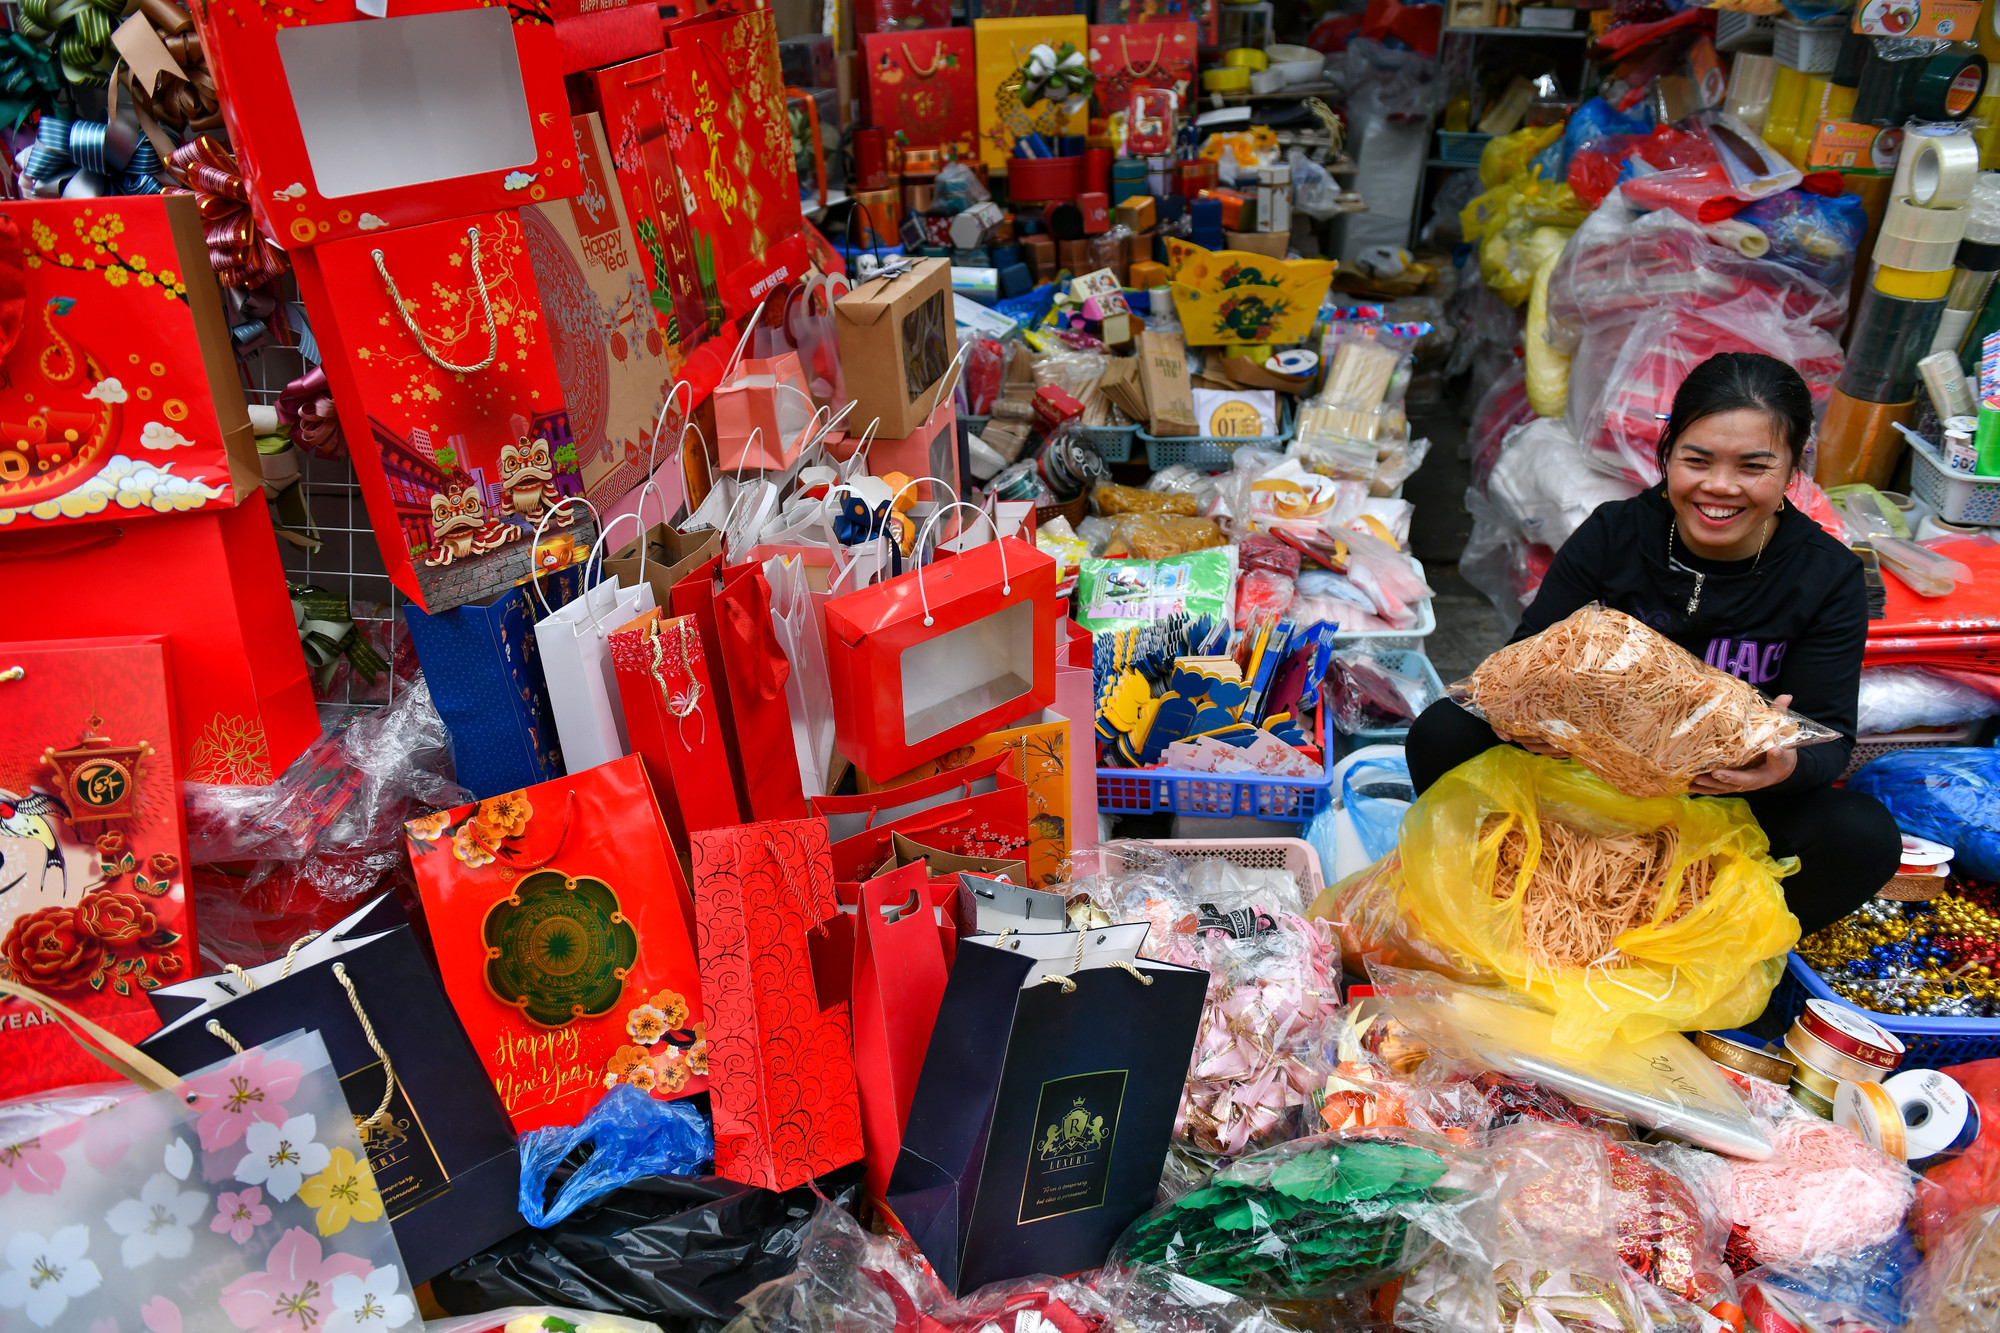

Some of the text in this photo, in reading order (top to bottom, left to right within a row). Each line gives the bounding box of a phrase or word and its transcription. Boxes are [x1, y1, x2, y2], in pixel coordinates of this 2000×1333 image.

[580, 0, 600, 13] HAPPY
[600, 0, 613, 10] NEW
[580, 229, 622, 260] Happy
[586, 250, 629, 273] new Year
[749, 265, 790, 299] HAPPY NEW YEAR
[1951, 454, 1977, 473] 502
[494, 1026, 580, 1071] Happy
[1711, 1040, 1744, 1064] Happy
[1856, 1045, 1875, 1060] best
[496, 1062, 603, 1111] New Year
[1069, 1118, 1081, 1135] R
[370, 1153, 398, 1172] URY
[1049, 1154, 1090, 1171] LUXURY
